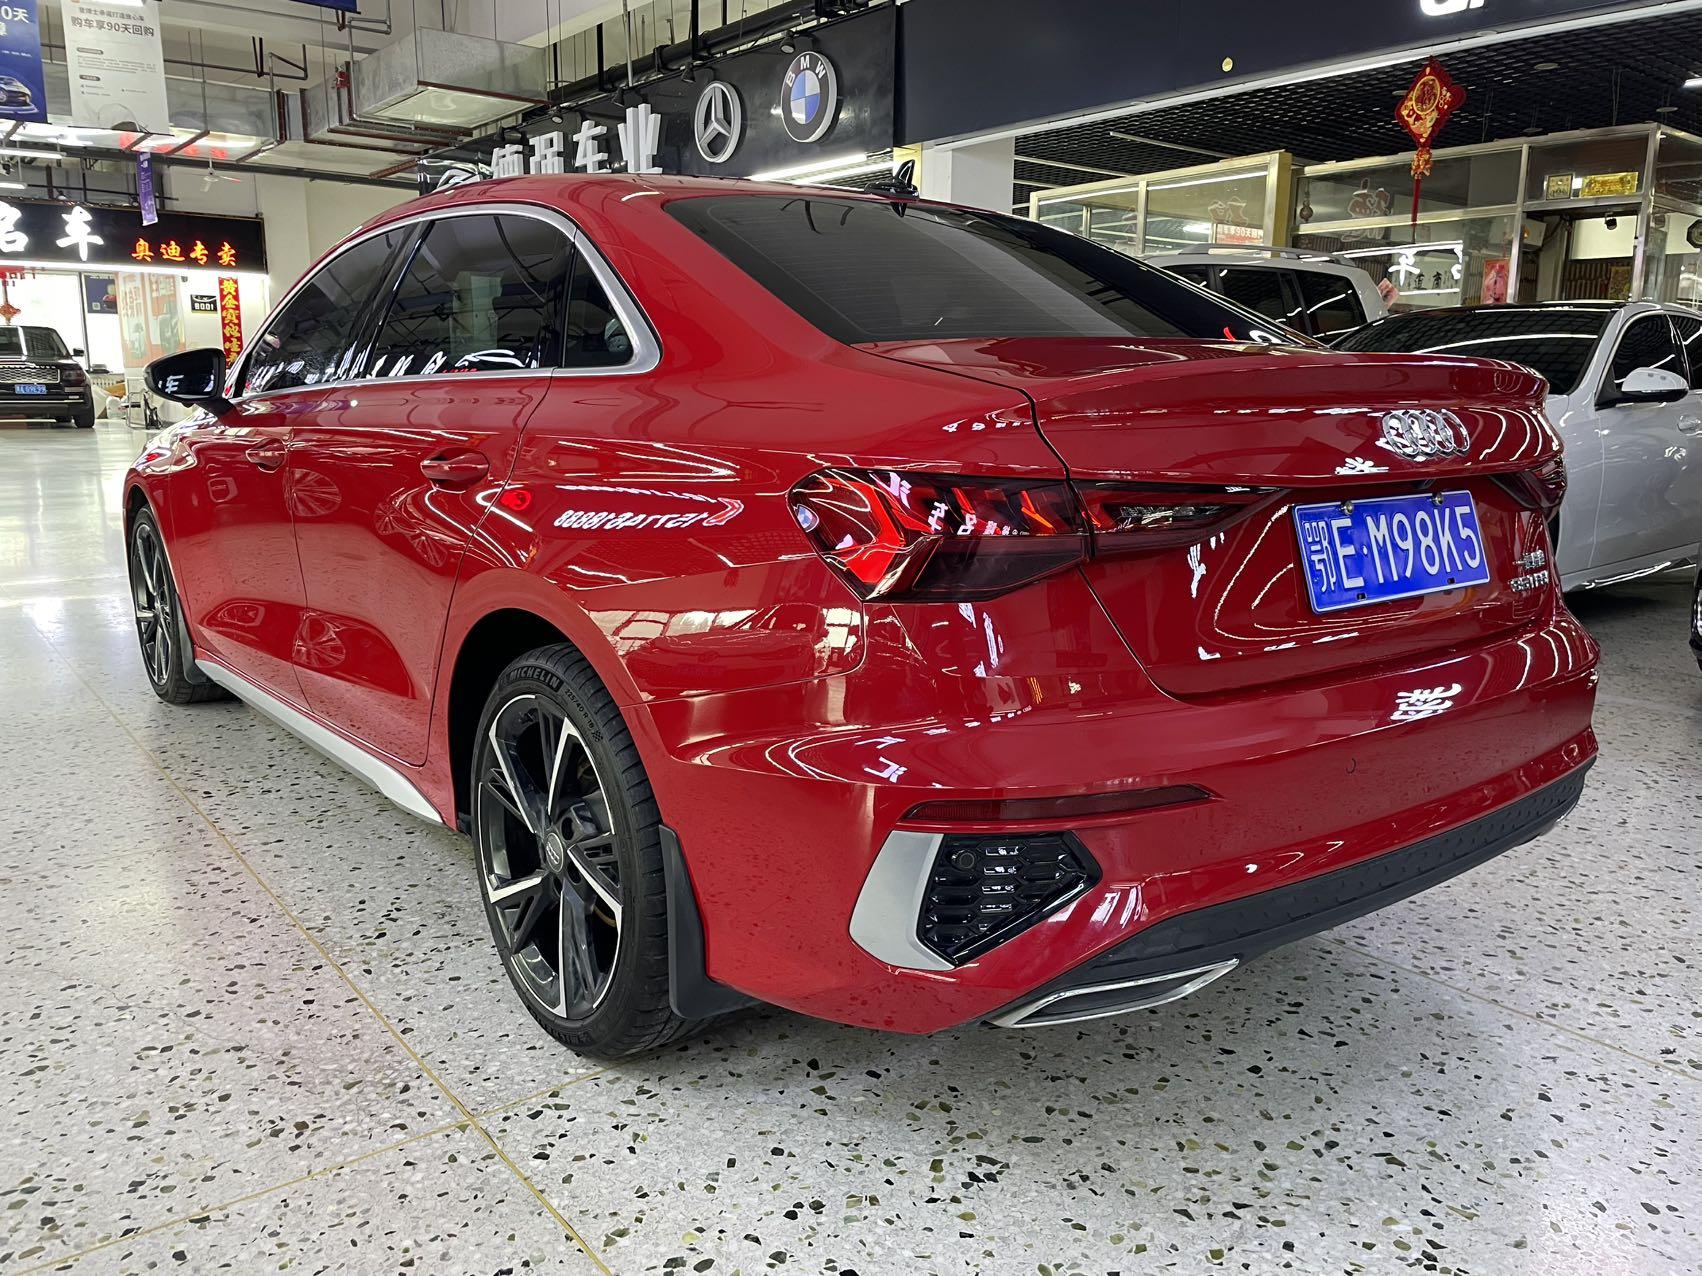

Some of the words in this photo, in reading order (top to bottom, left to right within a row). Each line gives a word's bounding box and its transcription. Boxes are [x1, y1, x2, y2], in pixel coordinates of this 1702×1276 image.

[71, 16, 154, 37] 购车享90天回购
[786, 55, 826, 88] BMW
[131, 237, 237, 267] 奥迪专卖
[510, 665, 560, 690] MICHELIN
[565, 689, 584, 712] 225/40
